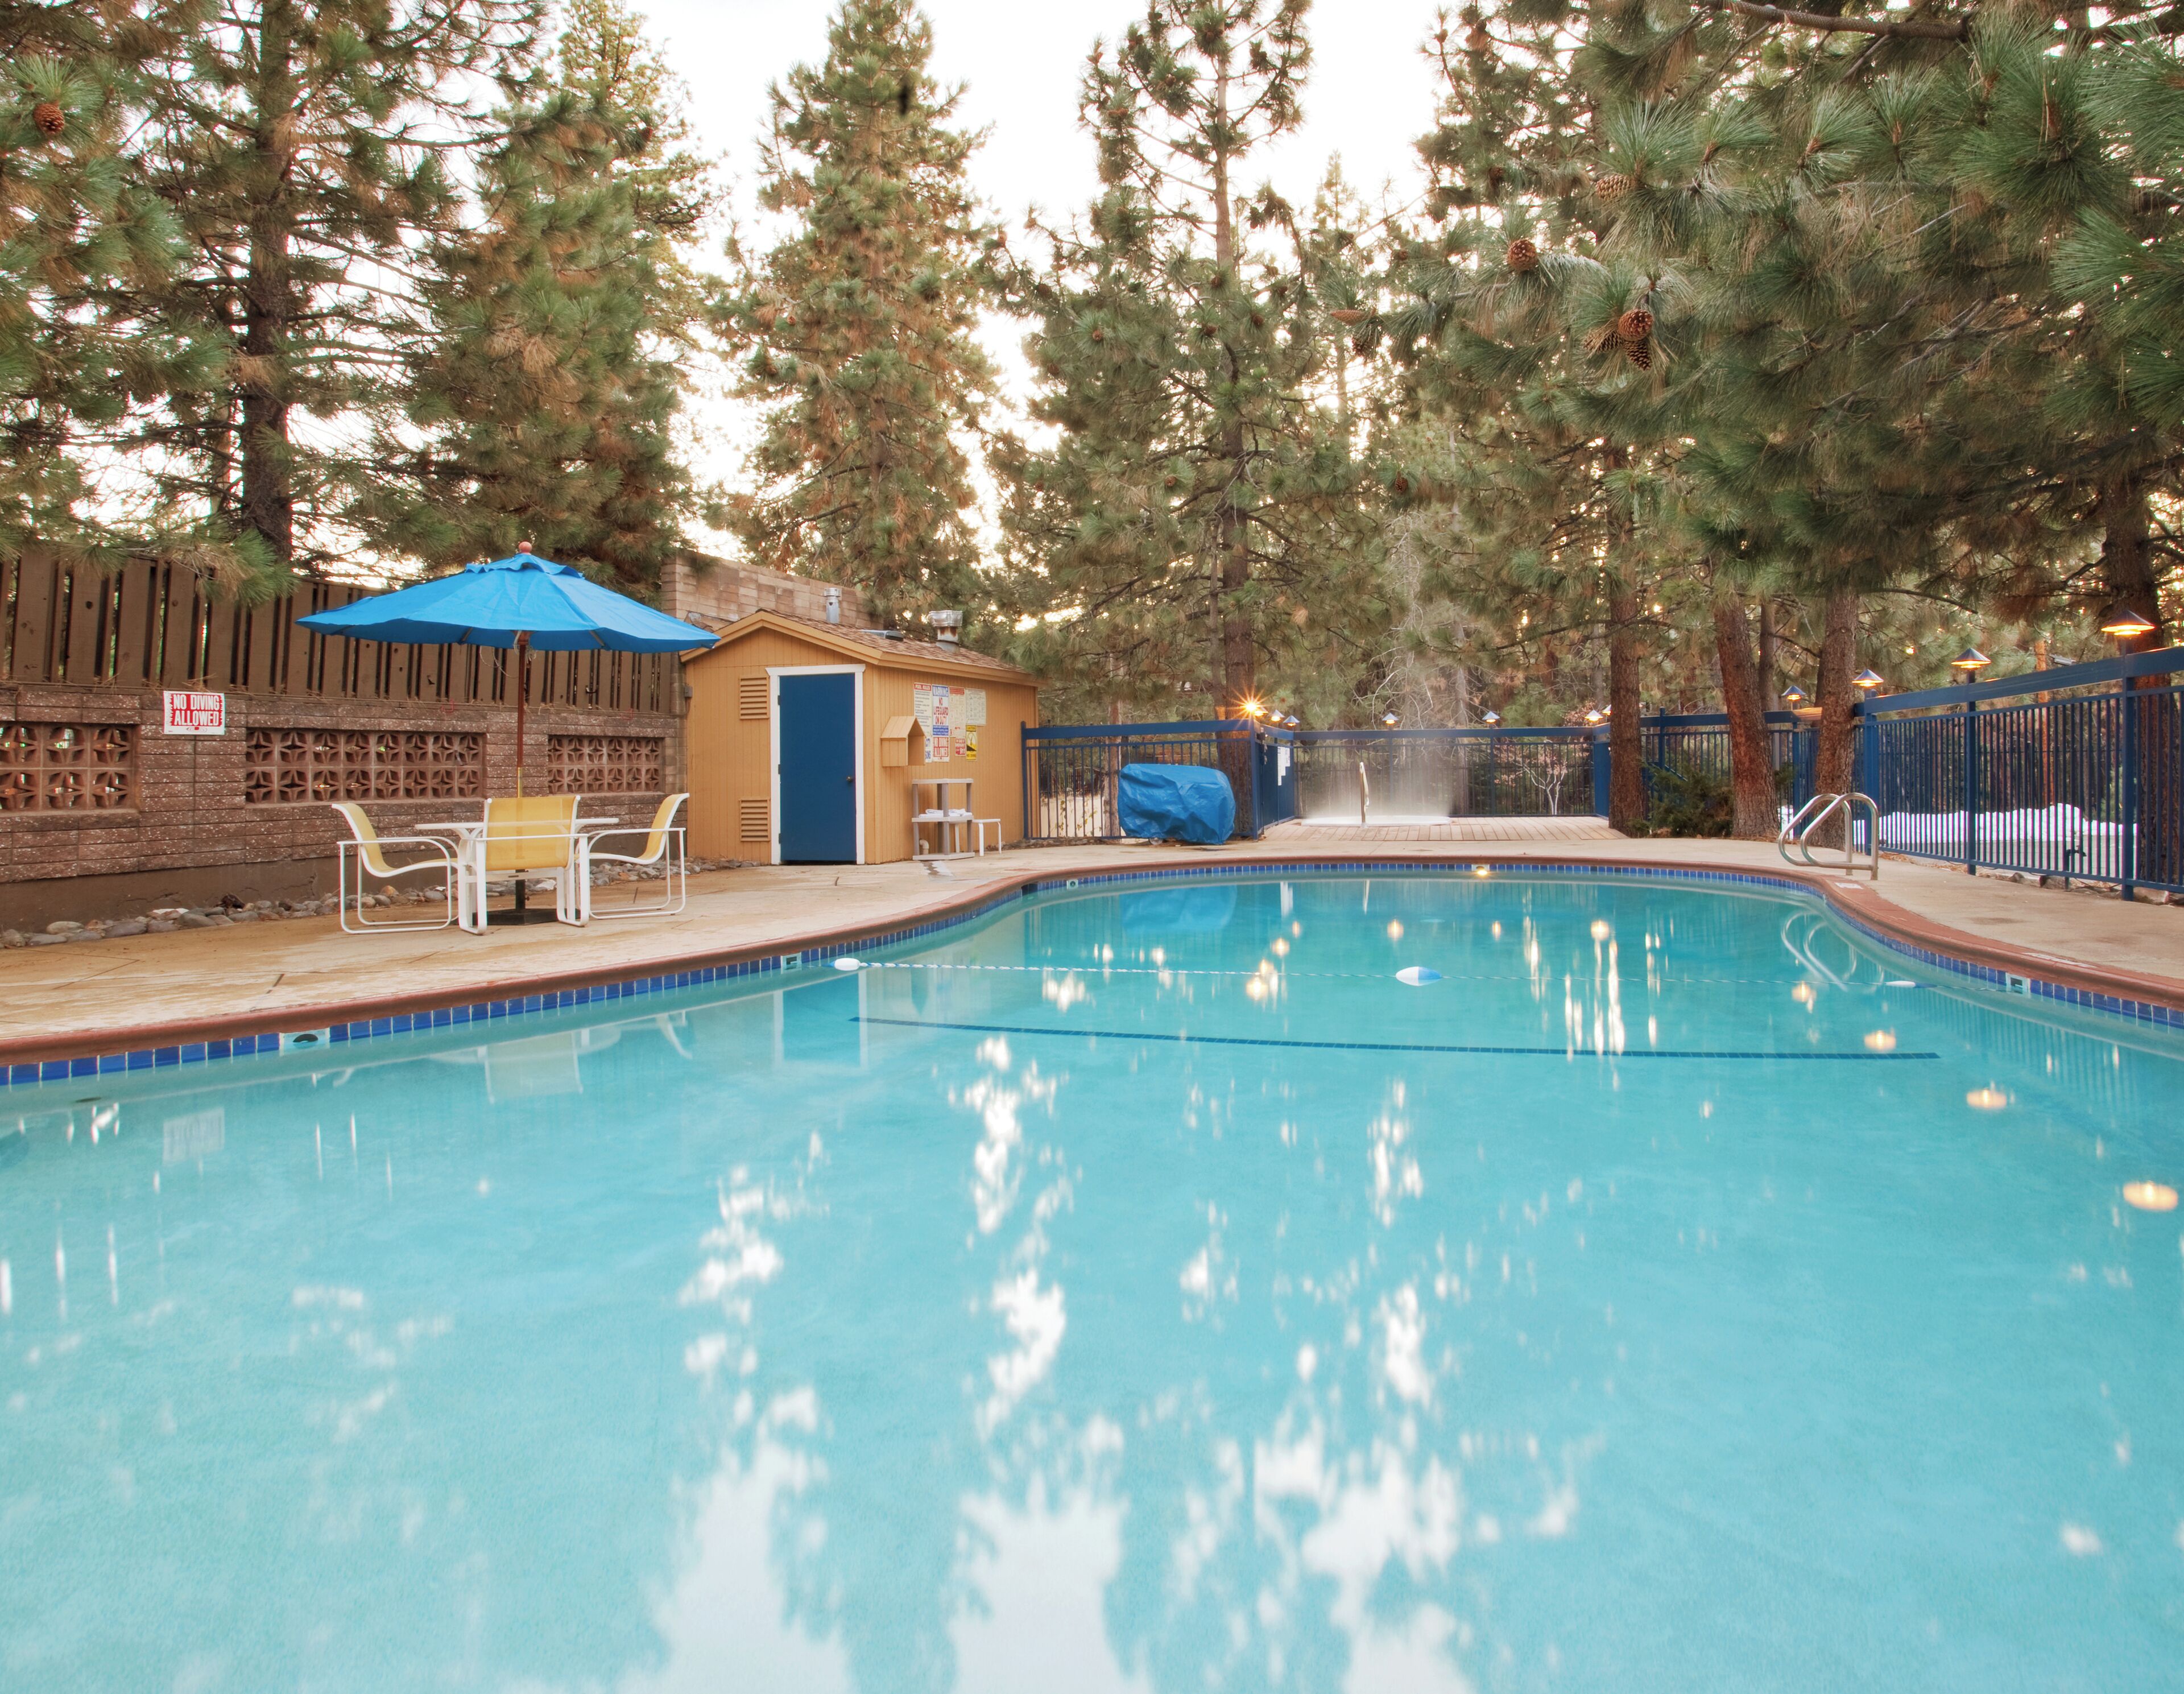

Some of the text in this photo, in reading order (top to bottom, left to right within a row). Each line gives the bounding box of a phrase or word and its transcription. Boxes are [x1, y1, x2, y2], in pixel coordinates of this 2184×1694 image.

[933, 686, 948, 696] WARNING
[173, 694, 220, 710] NO DIVING
[938, 697, 943, 705] NO
[934, 706, 948, 716] LIFEGUARD
[174, 710, 220, 726] ALLOWED
[934, 747, 948, 757] ALLOWED
